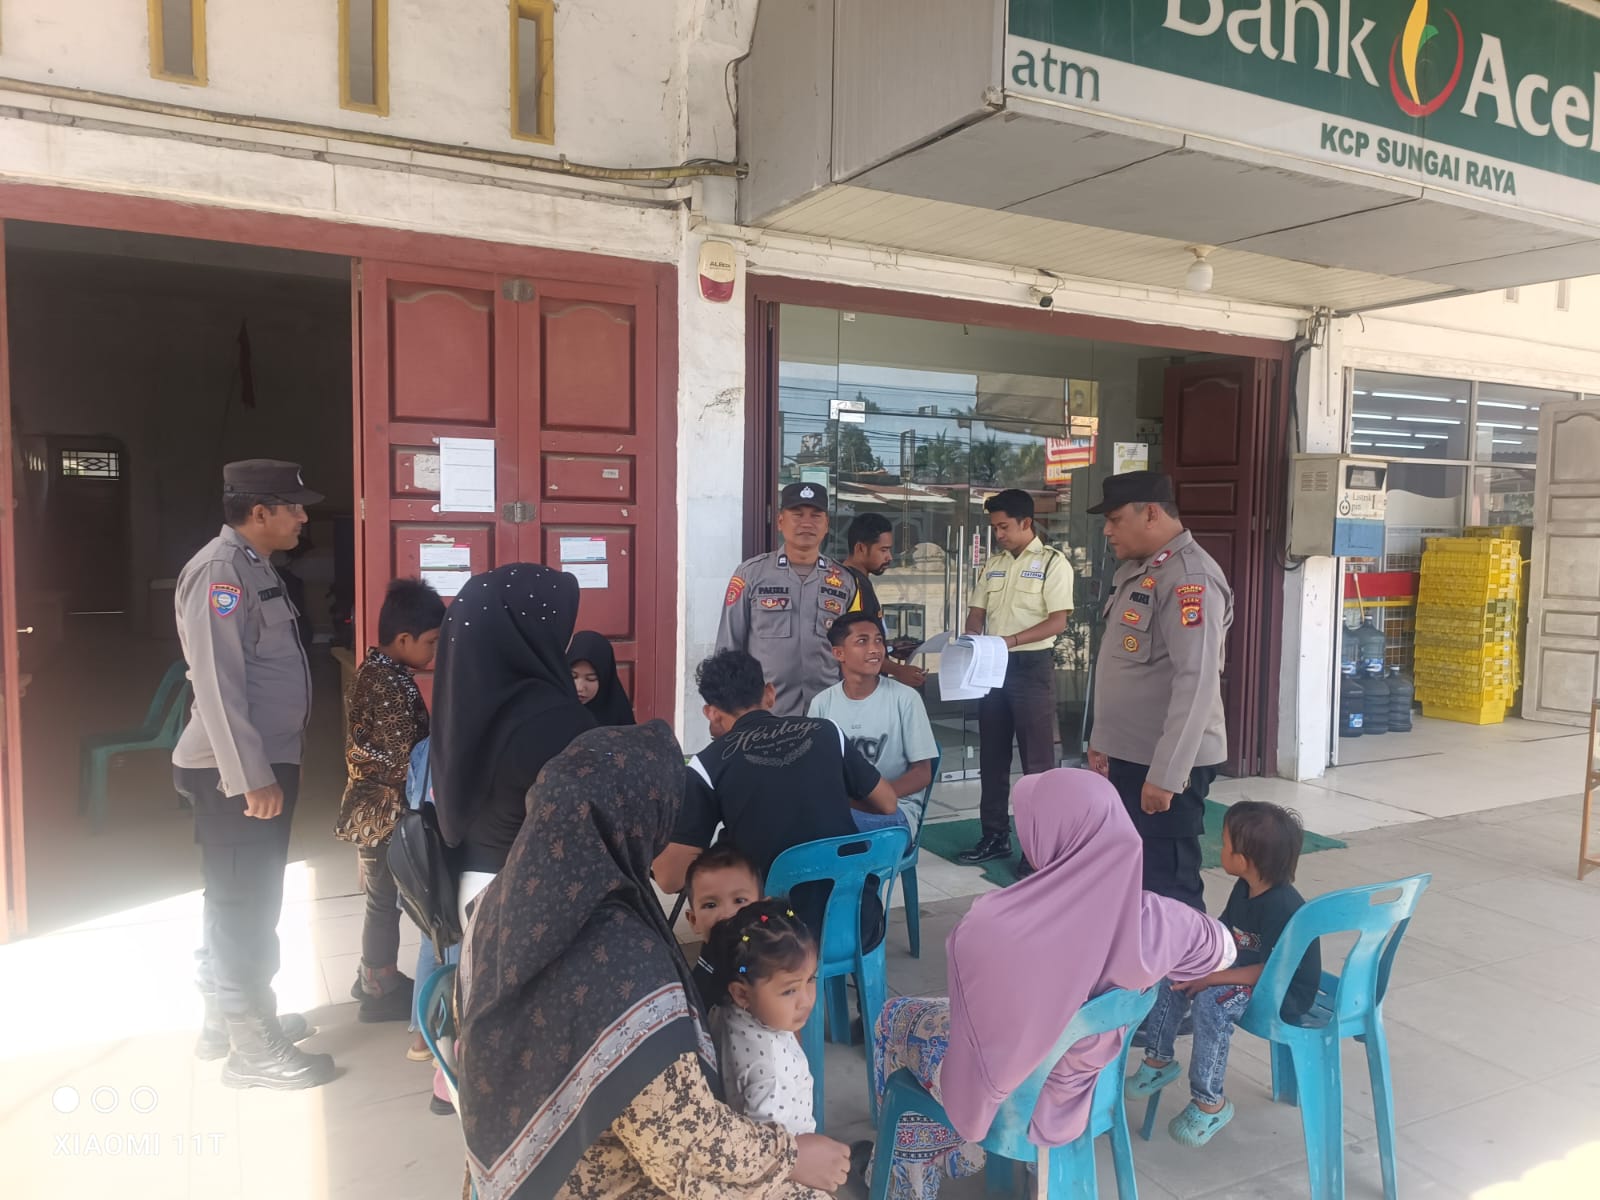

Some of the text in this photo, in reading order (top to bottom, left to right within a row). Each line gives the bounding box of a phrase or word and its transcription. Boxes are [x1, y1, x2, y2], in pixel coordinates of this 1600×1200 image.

[1011, 48, 1100, 101] atm
[1460, 32, 1600, 152] Ace
[1320, 122, 1516, 195] KCP SUNGAI RAYA
[721, 720, 822, 760] Heritage
